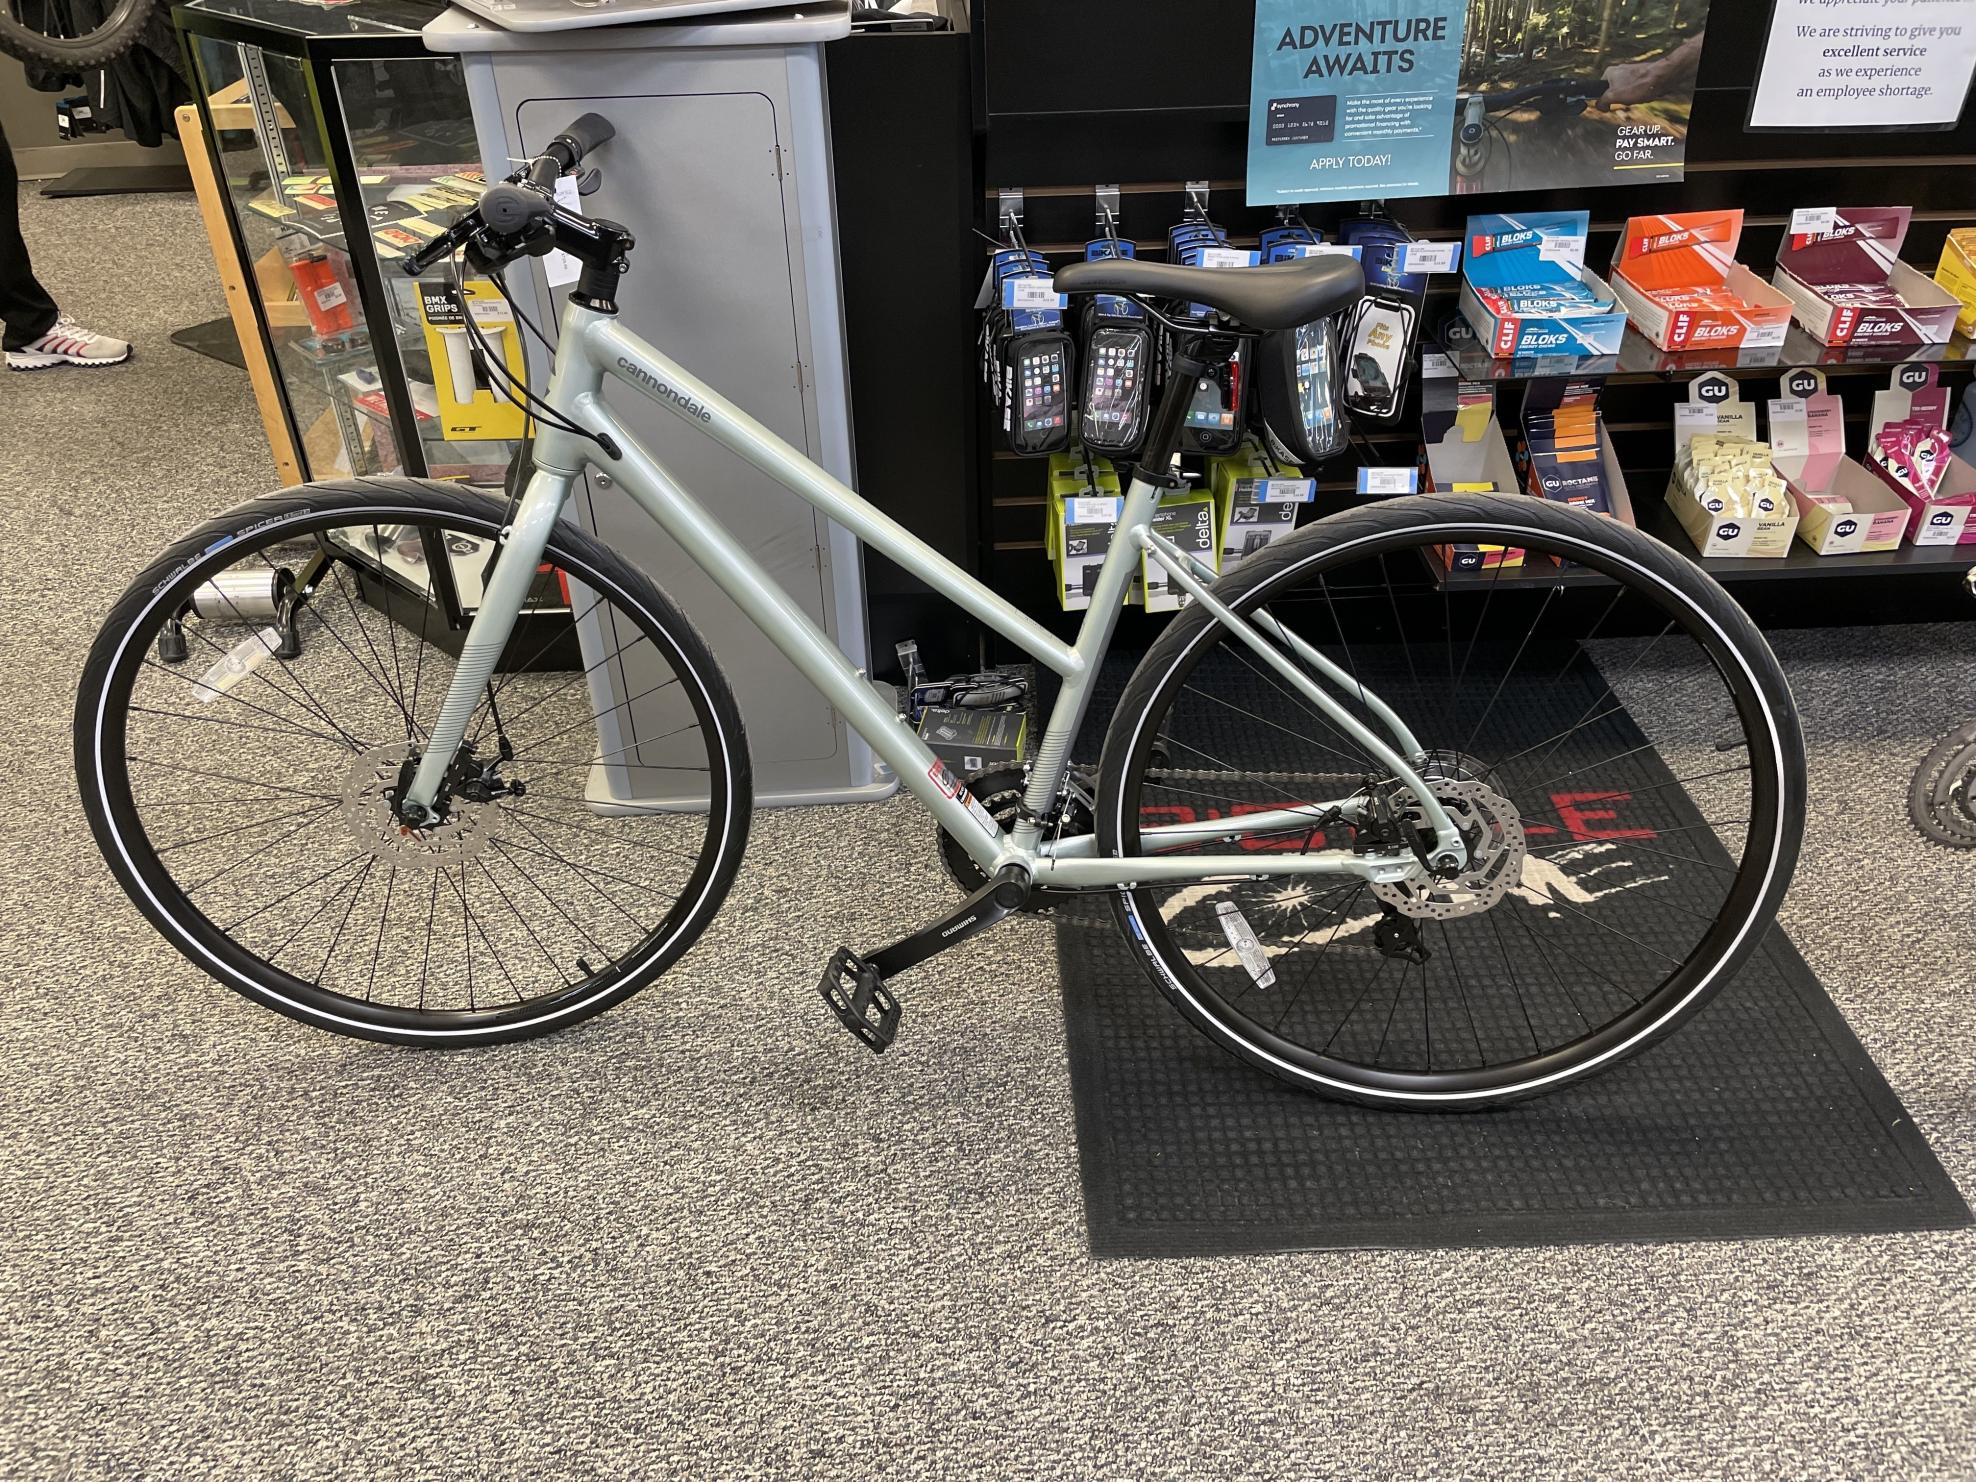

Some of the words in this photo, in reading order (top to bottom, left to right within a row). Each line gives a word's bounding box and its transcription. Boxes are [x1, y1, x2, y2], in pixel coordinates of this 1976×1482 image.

[1277, 17, 1447, 51] ADVENTURE
[1796, 25, 1817, 38] We
[1819, 29, 1840, 38] are
[1842, 25, 1892, 40] striving
[1895, 26, 1908, 37] to
[1908, 24, 1936, 40] give
[1937, 26, 1963, 39] you
[1822, 45, 1880, 58] excellent
[1882, 45, 1927, 57] service
[1303, 49, 1415, 79] AWAITS
[1818, 67, 1832, 78] as
[1835, 67, 1853, 78] we
[1855, 65, 1922, 80] experience
[1796, 86, 1813, 97] an
[1816, 84, 1876, 100] employee
[1878, 84, 1934, 99] shortage.
[1413, 103, 1432, 111] looking
[1344, 122, 1375, 130] promotional
[1373, 128, 1392, 136] monthly
[1617, 125, 1645, 136] GEAR
[1647, 124, 1661, 135] UP.
[1615, 138, 1635, 149] PAY
[1637, 136, 1675, 147] SMART.
[1614, 151, 1631, 161] GO
[1633, 149, 1654, 160] FAR.
[1310, 157, 1345, 170] APPLY
[1348, 155, 1391, 168] TODAY!
[1502, 230, 1533, 243] BLOKS
[1658, 231, 1690, 245] BLOKS
[1823, 226, 1856, 239] BLOKS
[424, 296, 448, 305] BMX
[1520, 300, 1558, 308] BLOKS
[426, 304, 458, 313] GRIPS
[1673, 314, 1692, 342] CLIF
[1836, 309, 1854, 337] CLIF
[1857, 322, 1904, 333] BLOKS
[1368, 328, 1393, 342] Any
[1449, 328, 1473, 339] GU
[1501, 321, 1516, 349] CLIF
[1694, 326, 1740, 338] BLOKS
[1521, 334, 1569, 345] BLOKS
[1902, 371, 1926, 383] GU
[617, 357, 711, 423] cannondale
[1701, 386, 1726, 396] GU
[1792, 379, 1815, 391] GU
[1546, 480, 1560, 488] GU
[1562, 476, 1599, 487] ROCTANE
[1760, 501, 1773, 509] GU
[1932, 516, 1952, 524] GU
[1195, 511, 1210, 548] delta
[1719, 528, 1738, 536] GU
[1836, 525, 1855, 533] GU
[152, 552, 201, 596] SCHWALBE
[941, 914, 977, 938] SHIMANO
[1141, 943, 1177, 990] SCHWALBE
